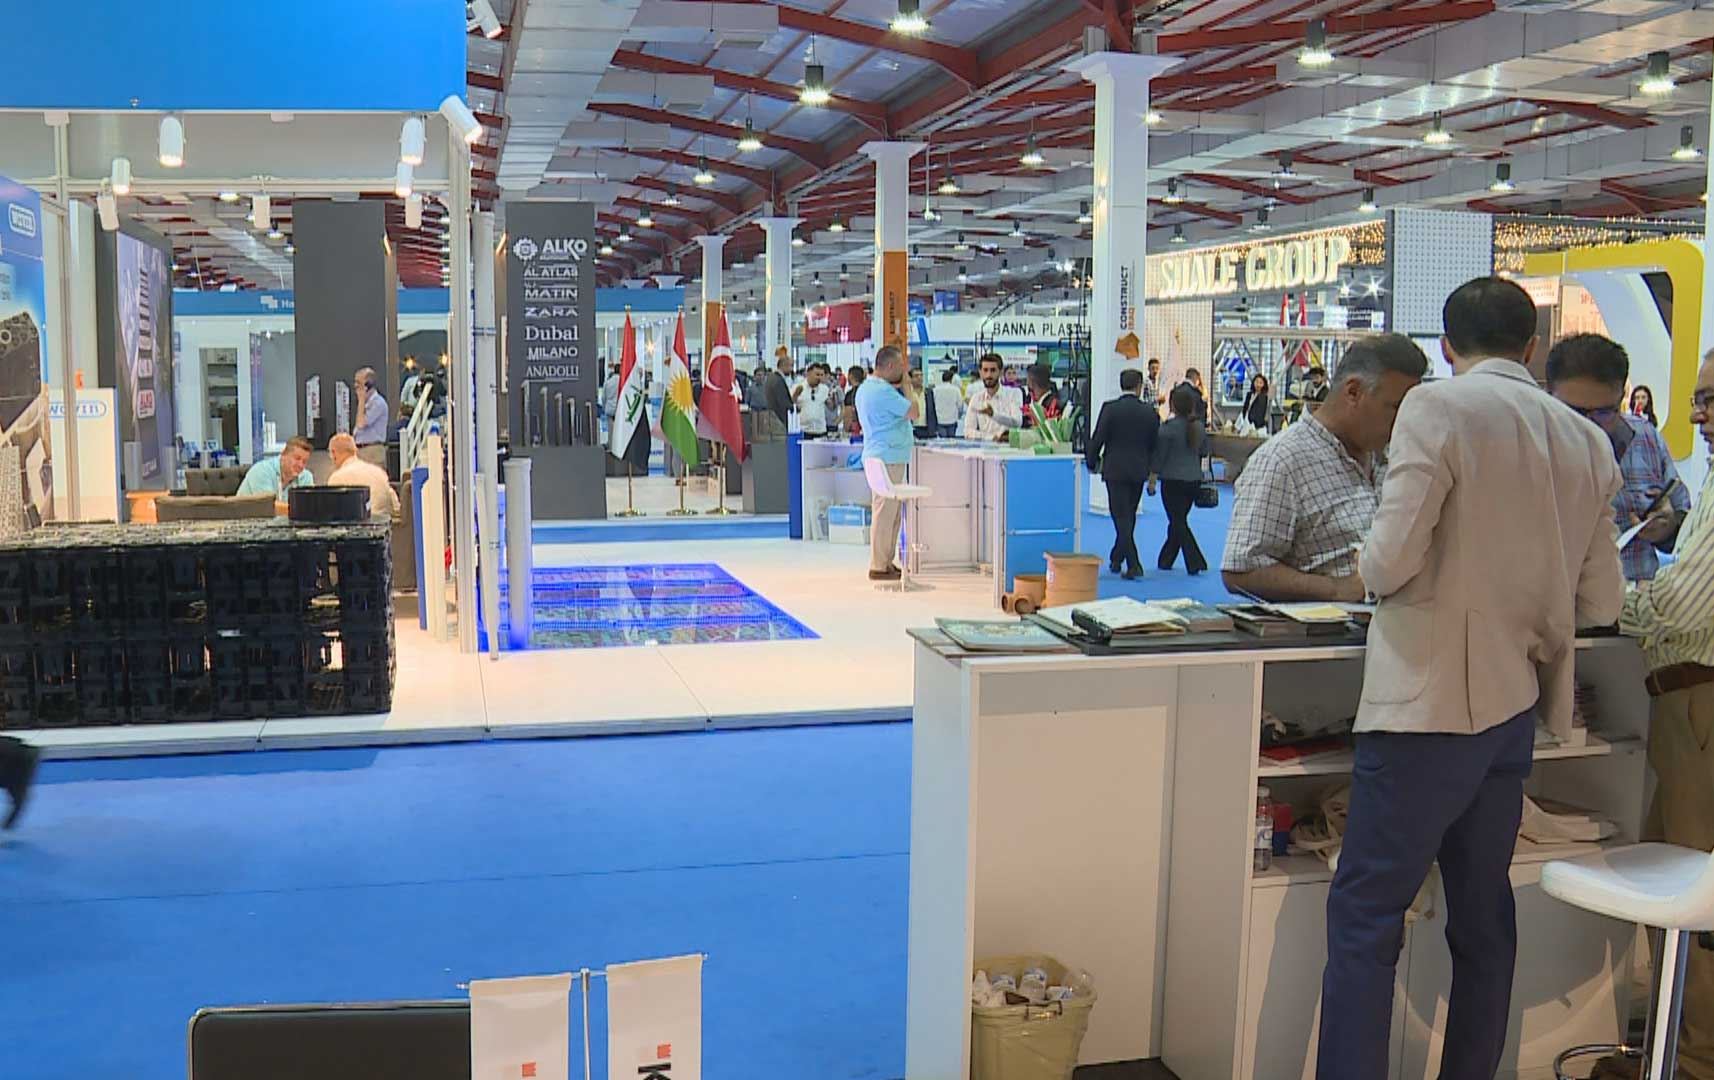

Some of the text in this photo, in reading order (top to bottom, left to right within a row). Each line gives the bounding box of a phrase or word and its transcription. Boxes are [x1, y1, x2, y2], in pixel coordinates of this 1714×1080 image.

[542, 239, 587, 260] ALKO
[1245, 236, 1351, 291] GROUP
[524, 289, 578, 298] MATIN
[1120, 265, 1128, 330] CONSTRUCT
[524, 307, 578, 317] ZARA
[993, 322, 1036, 336] BANNA
[527, 346, 578, 360] MILANO
[526, 365, 579, 377] ANADOLU
